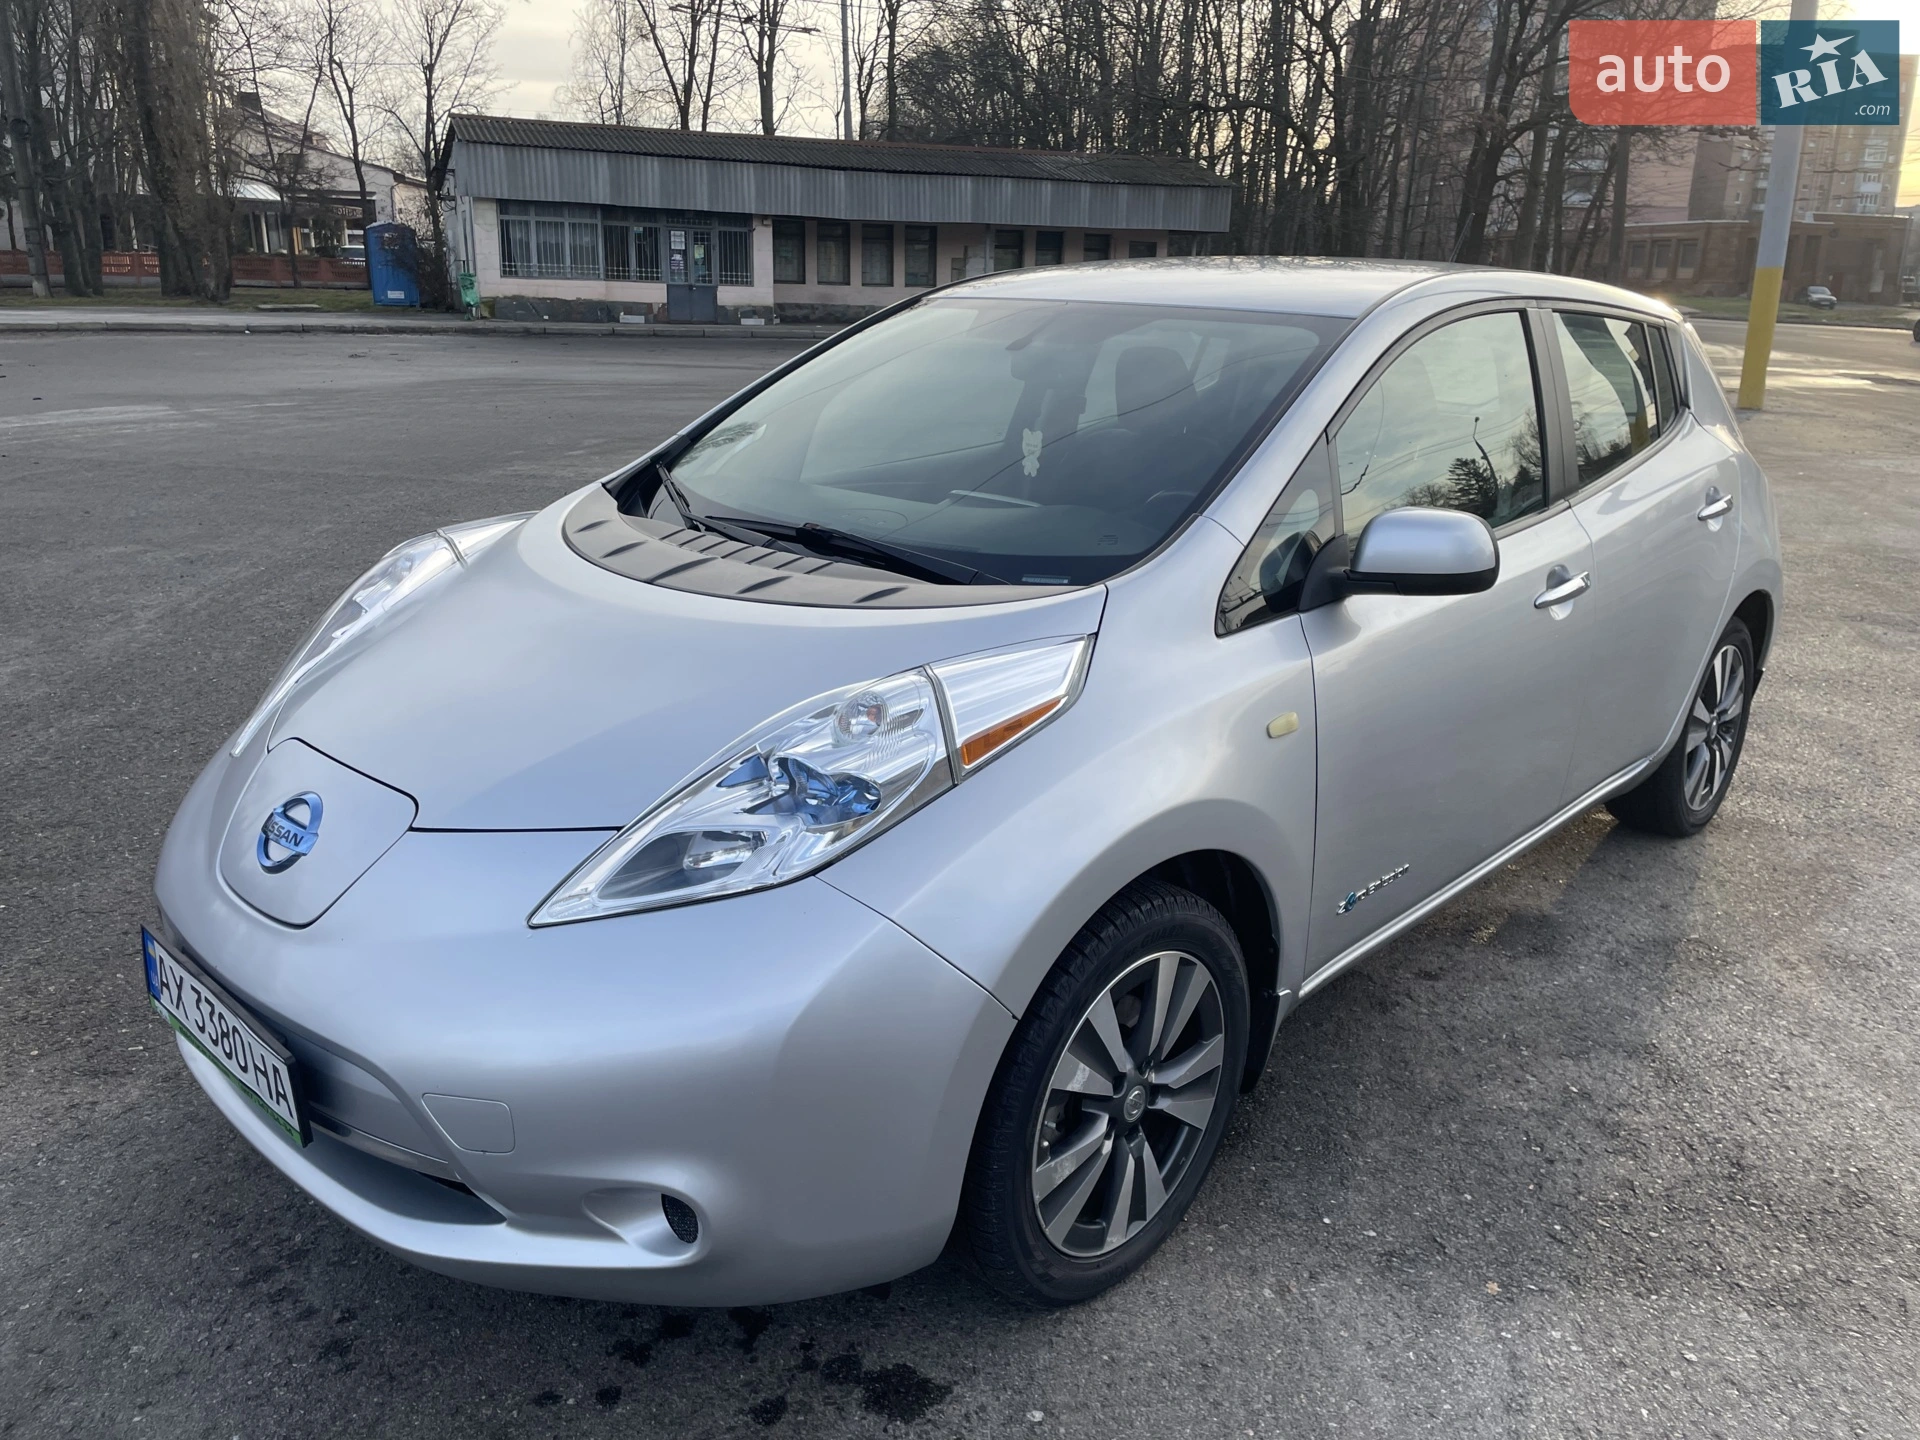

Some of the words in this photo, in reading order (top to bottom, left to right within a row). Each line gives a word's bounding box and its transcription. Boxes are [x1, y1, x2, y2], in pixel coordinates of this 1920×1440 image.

[158, 953, 190, 1021] AX
[190, 987, 249, 1074] 3380
[248, 1041, 294, 1119] HA
